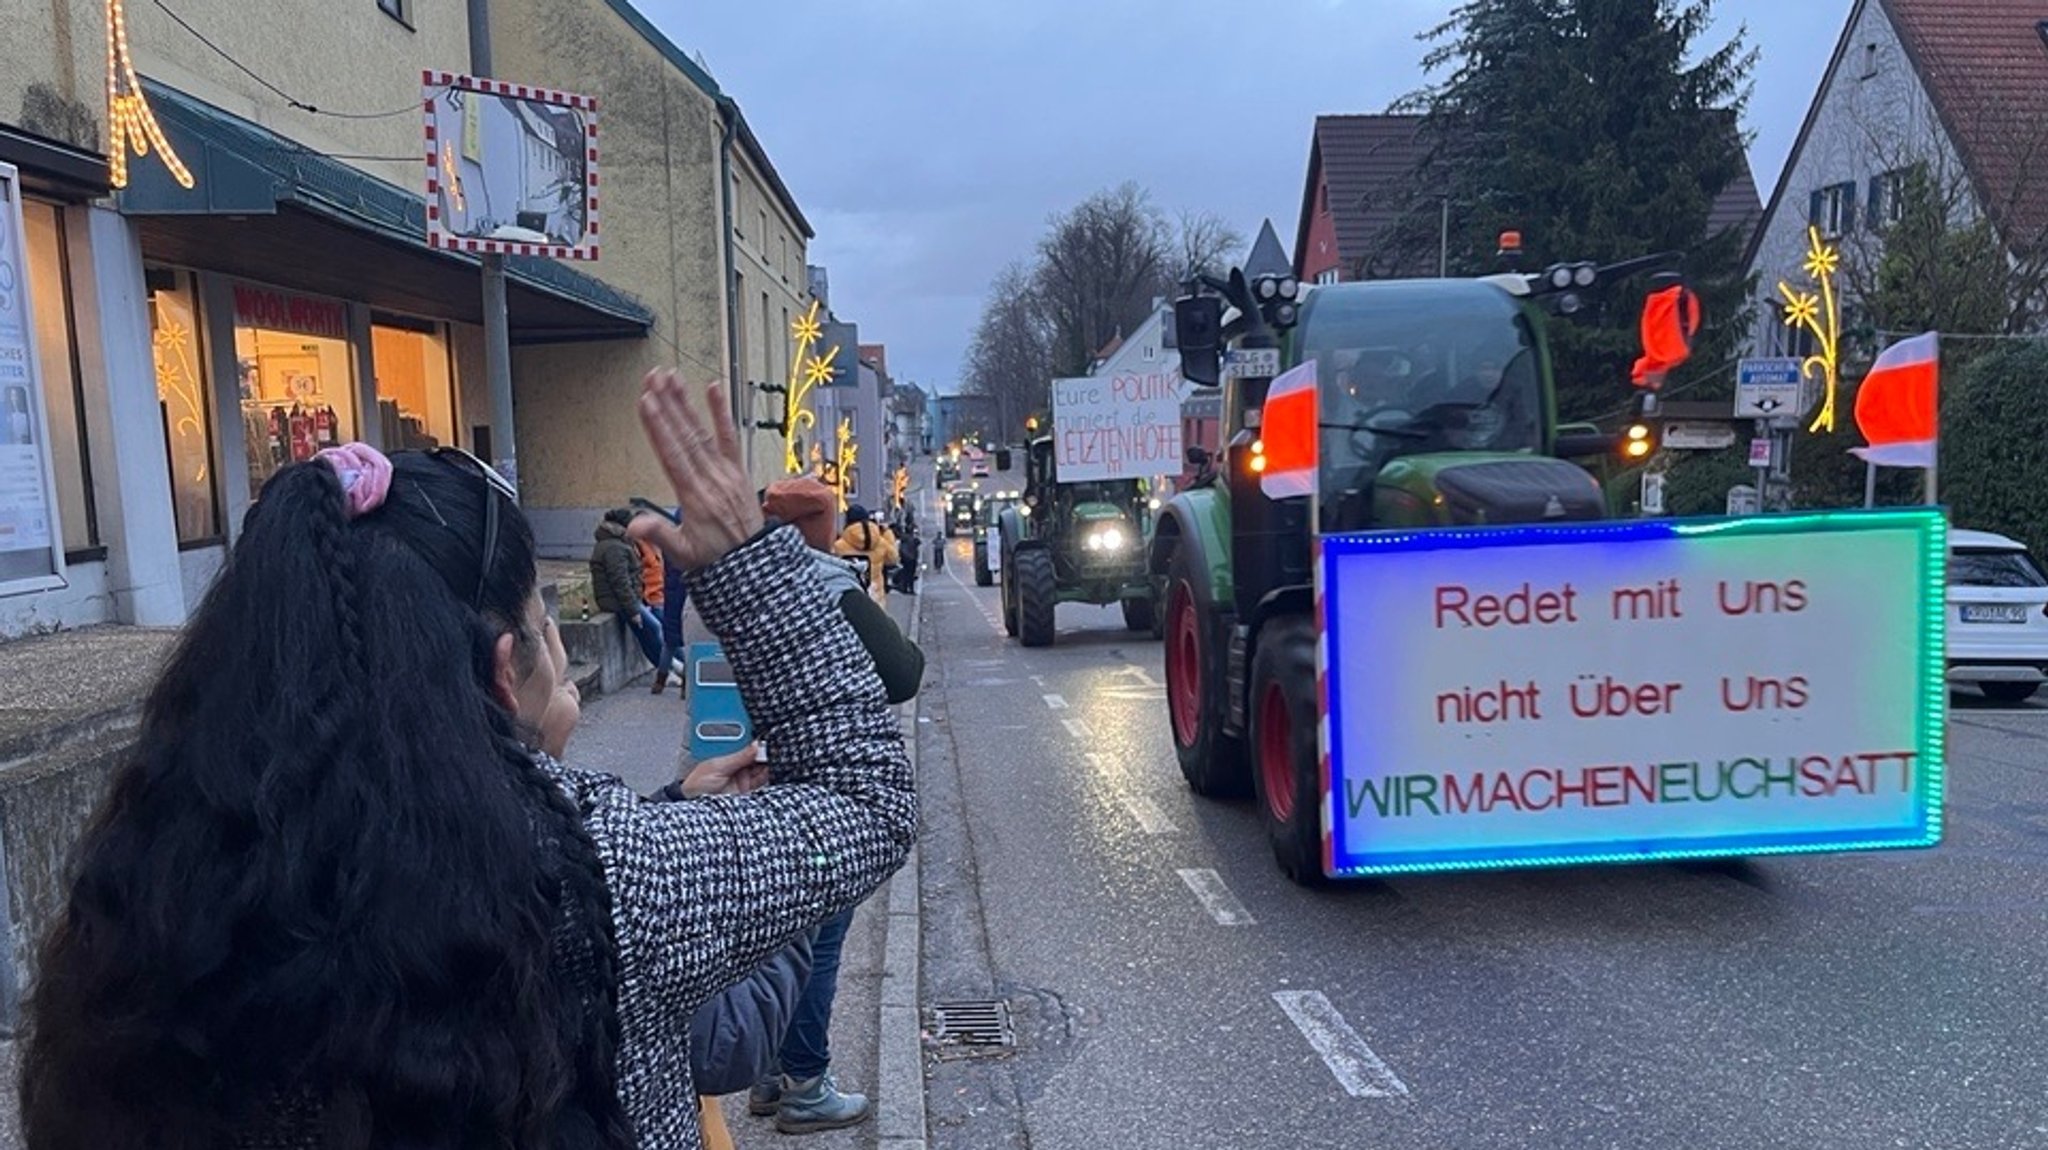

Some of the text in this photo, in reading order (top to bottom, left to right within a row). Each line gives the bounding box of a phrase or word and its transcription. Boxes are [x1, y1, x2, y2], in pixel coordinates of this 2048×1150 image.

[233, 284, 345, 337] WOOLWORTH
[1056, 371, 1180, 406] Eure POLITIK
[1435, 581, 1578, 628] Redet
[1613, 578, 1683, 620] mit
[1437, 679, 1542, 723] nicht
[1569, 673, 1683, 717] Über
